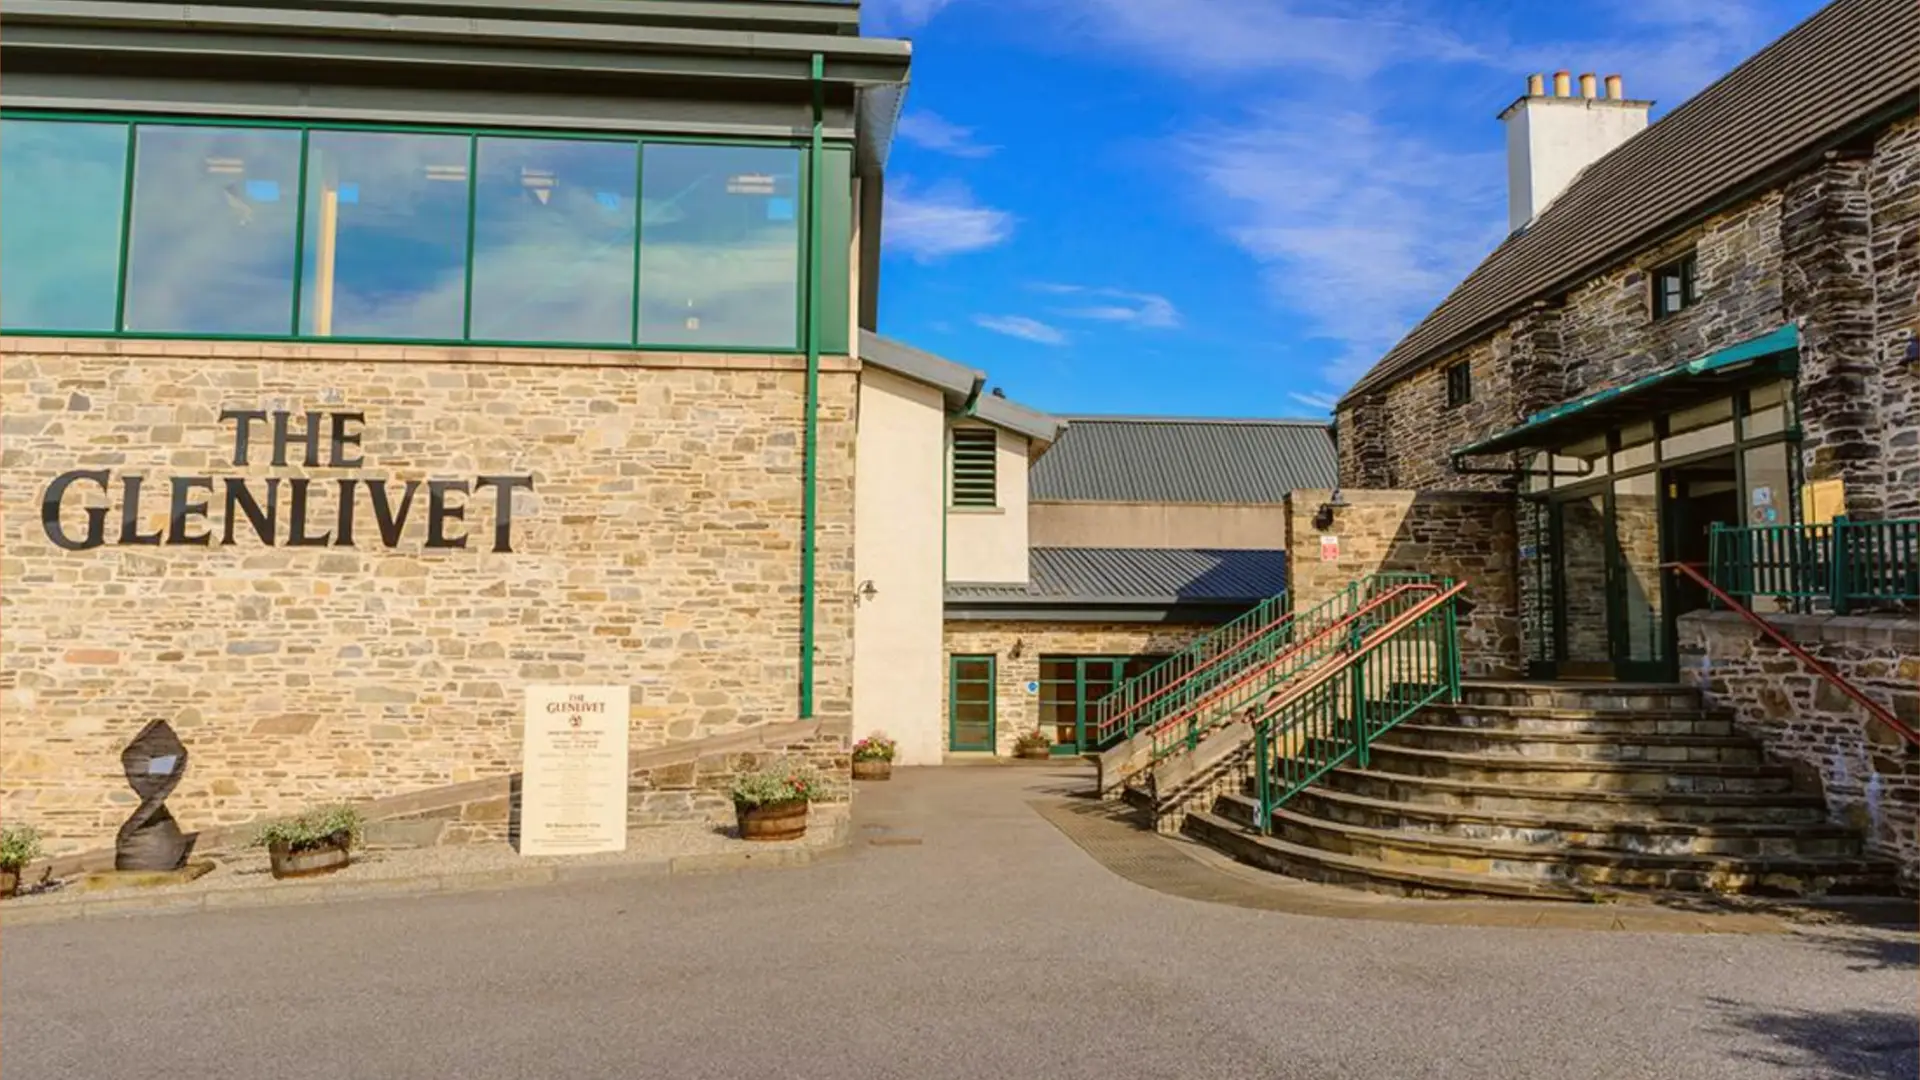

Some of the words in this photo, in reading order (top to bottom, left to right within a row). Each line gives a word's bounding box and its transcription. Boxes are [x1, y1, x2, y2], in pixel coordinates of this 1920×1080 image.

[217, 409, 366, 468] THE
[41, 468, 534, 553] GLENLIVET
[545, 702, 606, 714] GLENLIVET
[568, 693, 585, 702] THE
